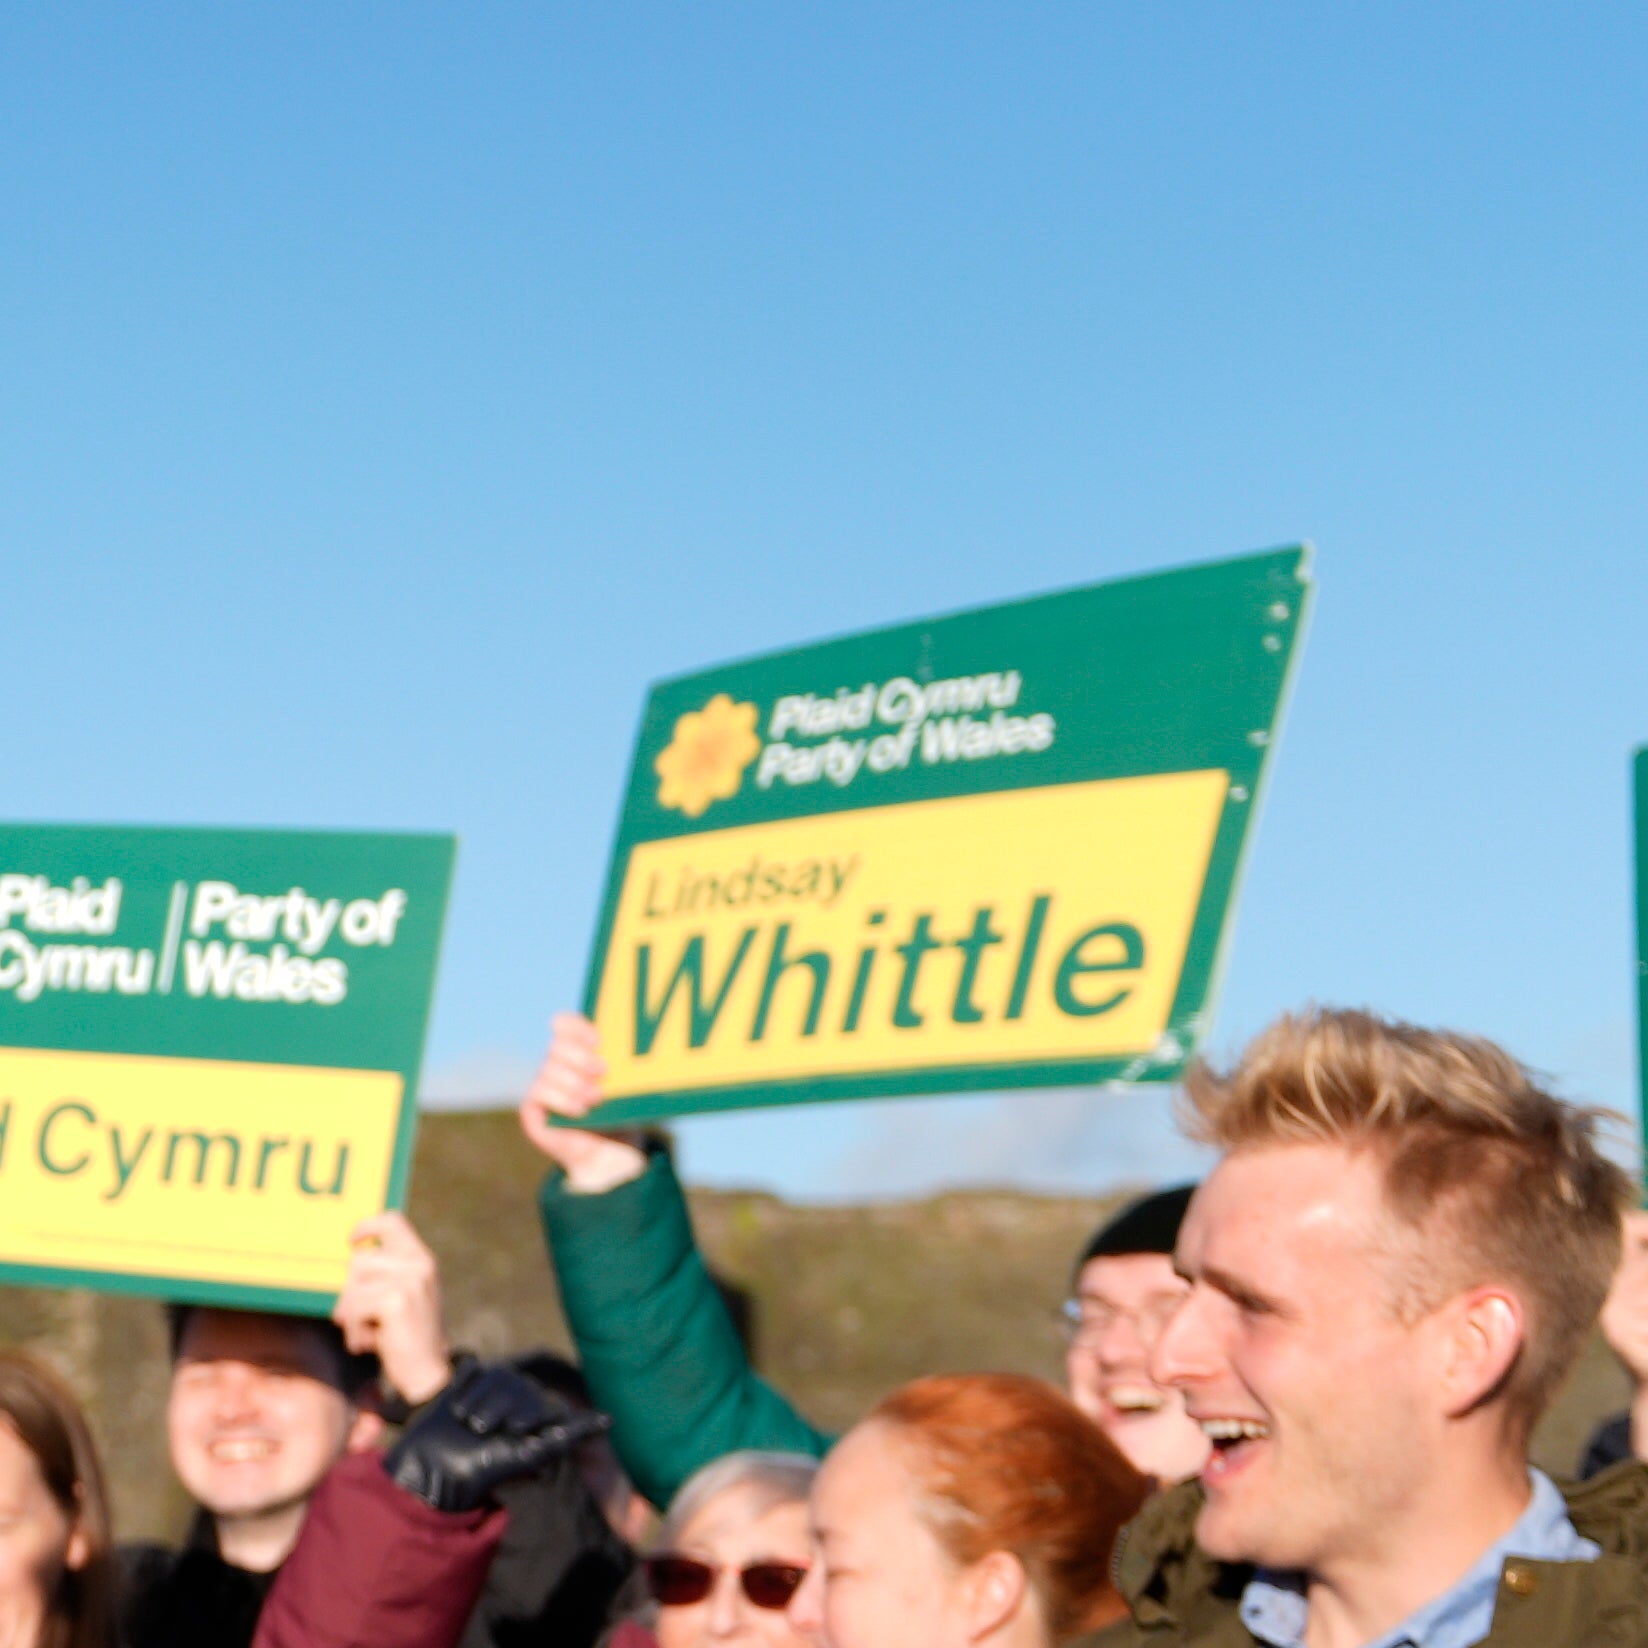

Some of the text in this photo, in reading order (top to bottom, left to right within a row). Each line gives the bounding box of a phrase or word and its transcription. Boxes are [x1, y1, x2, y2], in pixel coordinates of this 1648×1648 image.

[768, 670, 1022, 741] Plaid Cymru
[756, 710, 1055, 789] Party of Wales
[190, 881, 407, 953] Party of
[643, 852, 857, 920] Lindsay
[183, 939, 348, 1005] Wales
[632, 894, 1145, 1056] Whittle
[36, 1101, 349, 1200] Cymru
